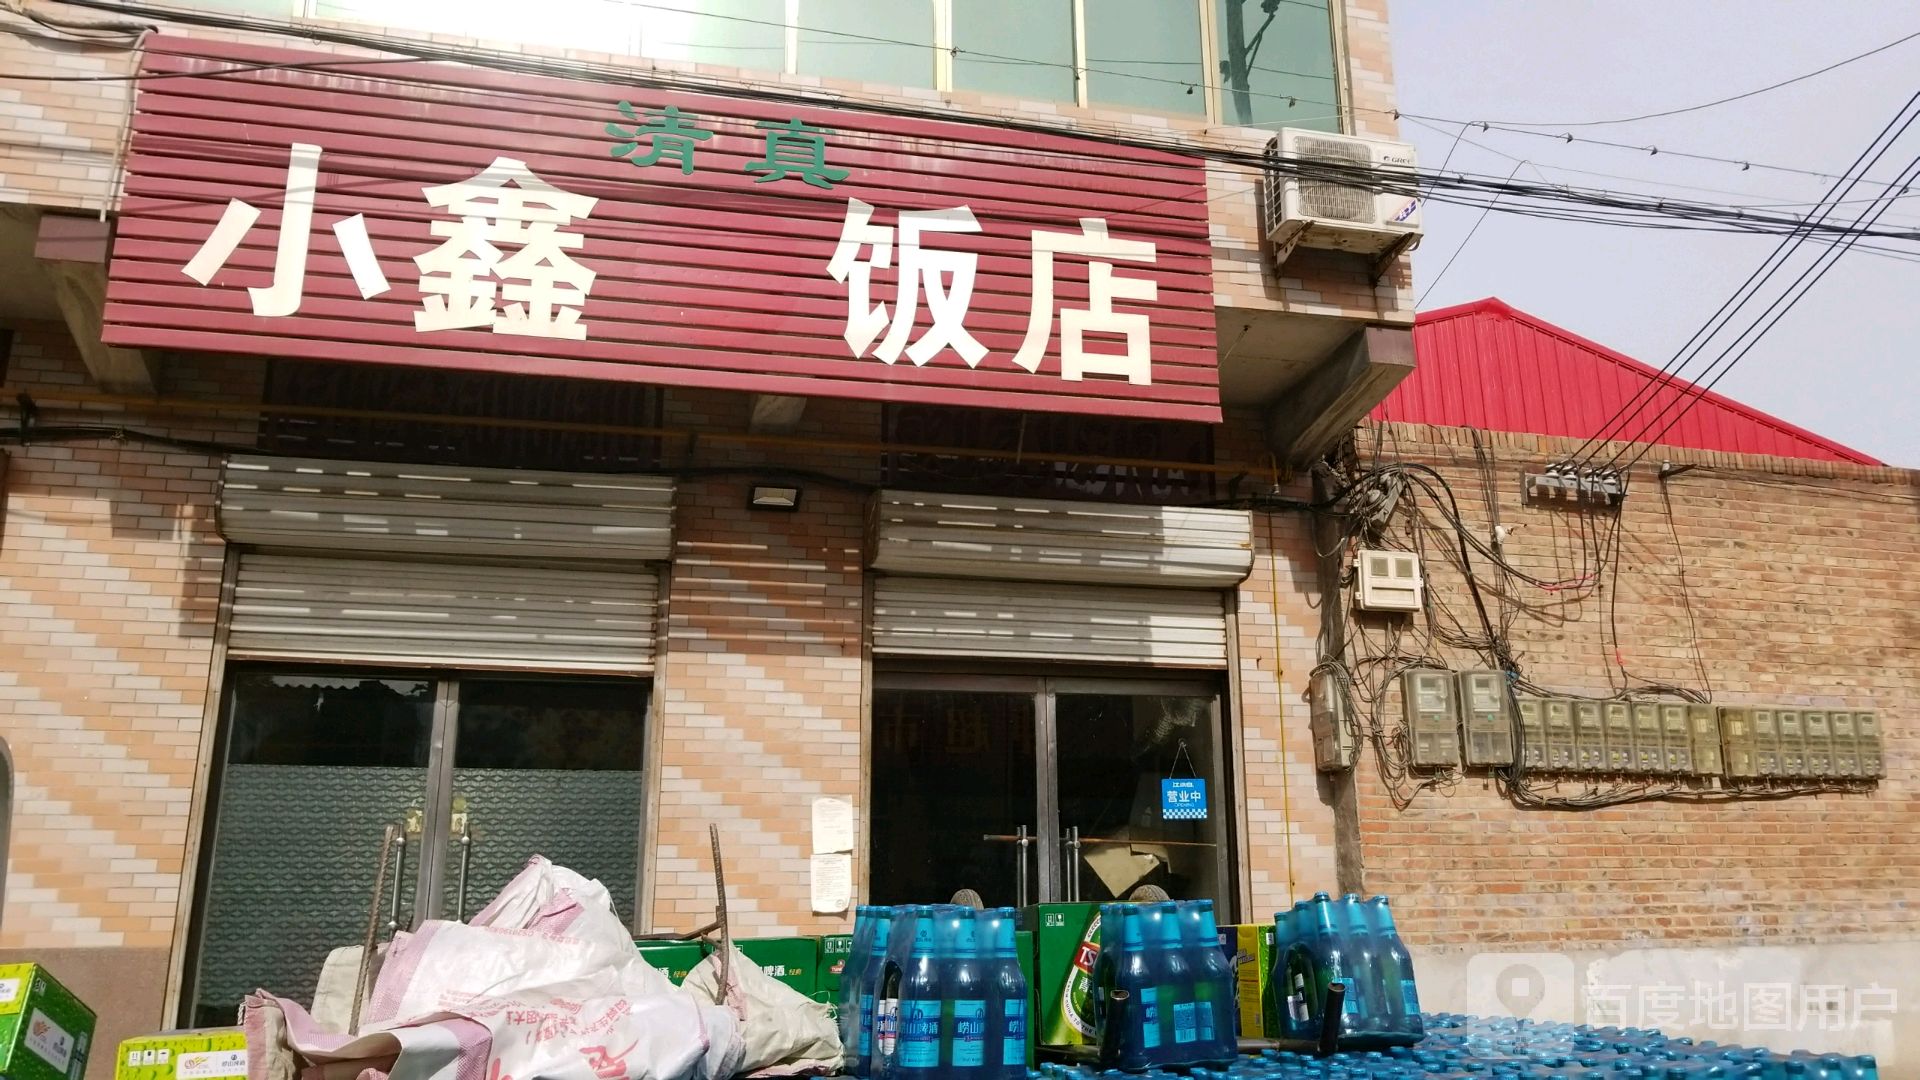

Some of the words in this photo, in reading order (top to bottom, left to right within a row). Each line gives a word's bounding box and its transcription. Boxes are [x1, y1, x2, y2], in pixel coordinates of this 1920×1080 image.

[604, 101, 850, 190] 清真
[181, 142, 599, 341] 小鑫
[825, 196, 1158, 386] 饭店
[1166, 790, 1201, 803] 营业中
[757, 965, 785, 977] 啤酒
